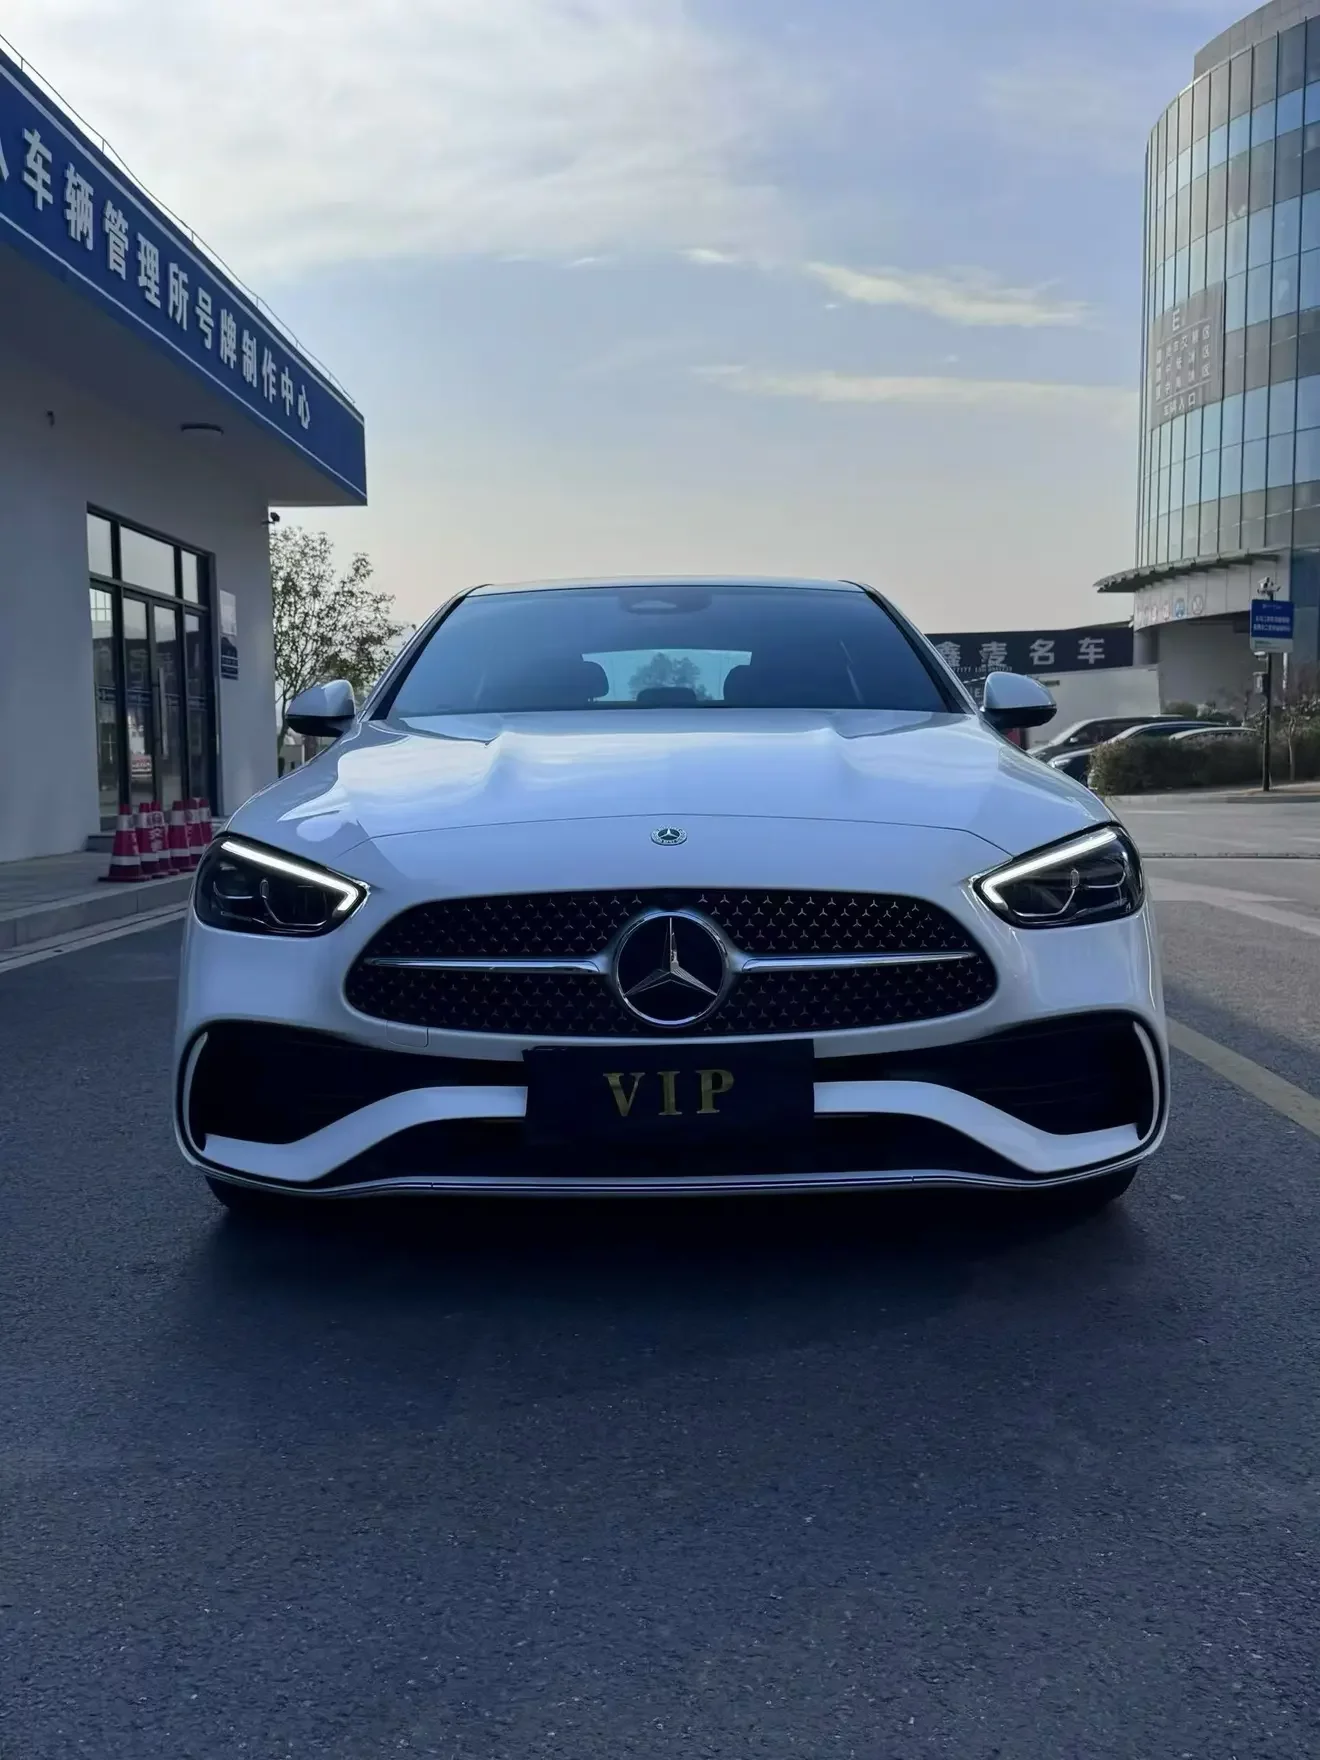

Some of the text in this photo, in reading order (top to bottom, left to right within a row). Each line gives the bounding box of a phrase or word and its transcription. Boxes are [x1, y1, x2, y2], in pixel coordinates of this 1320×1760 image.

[0, 128, 311, 429] 车辆管理所号牌制作中心
[603, 1070, 734, 1116] VIP
